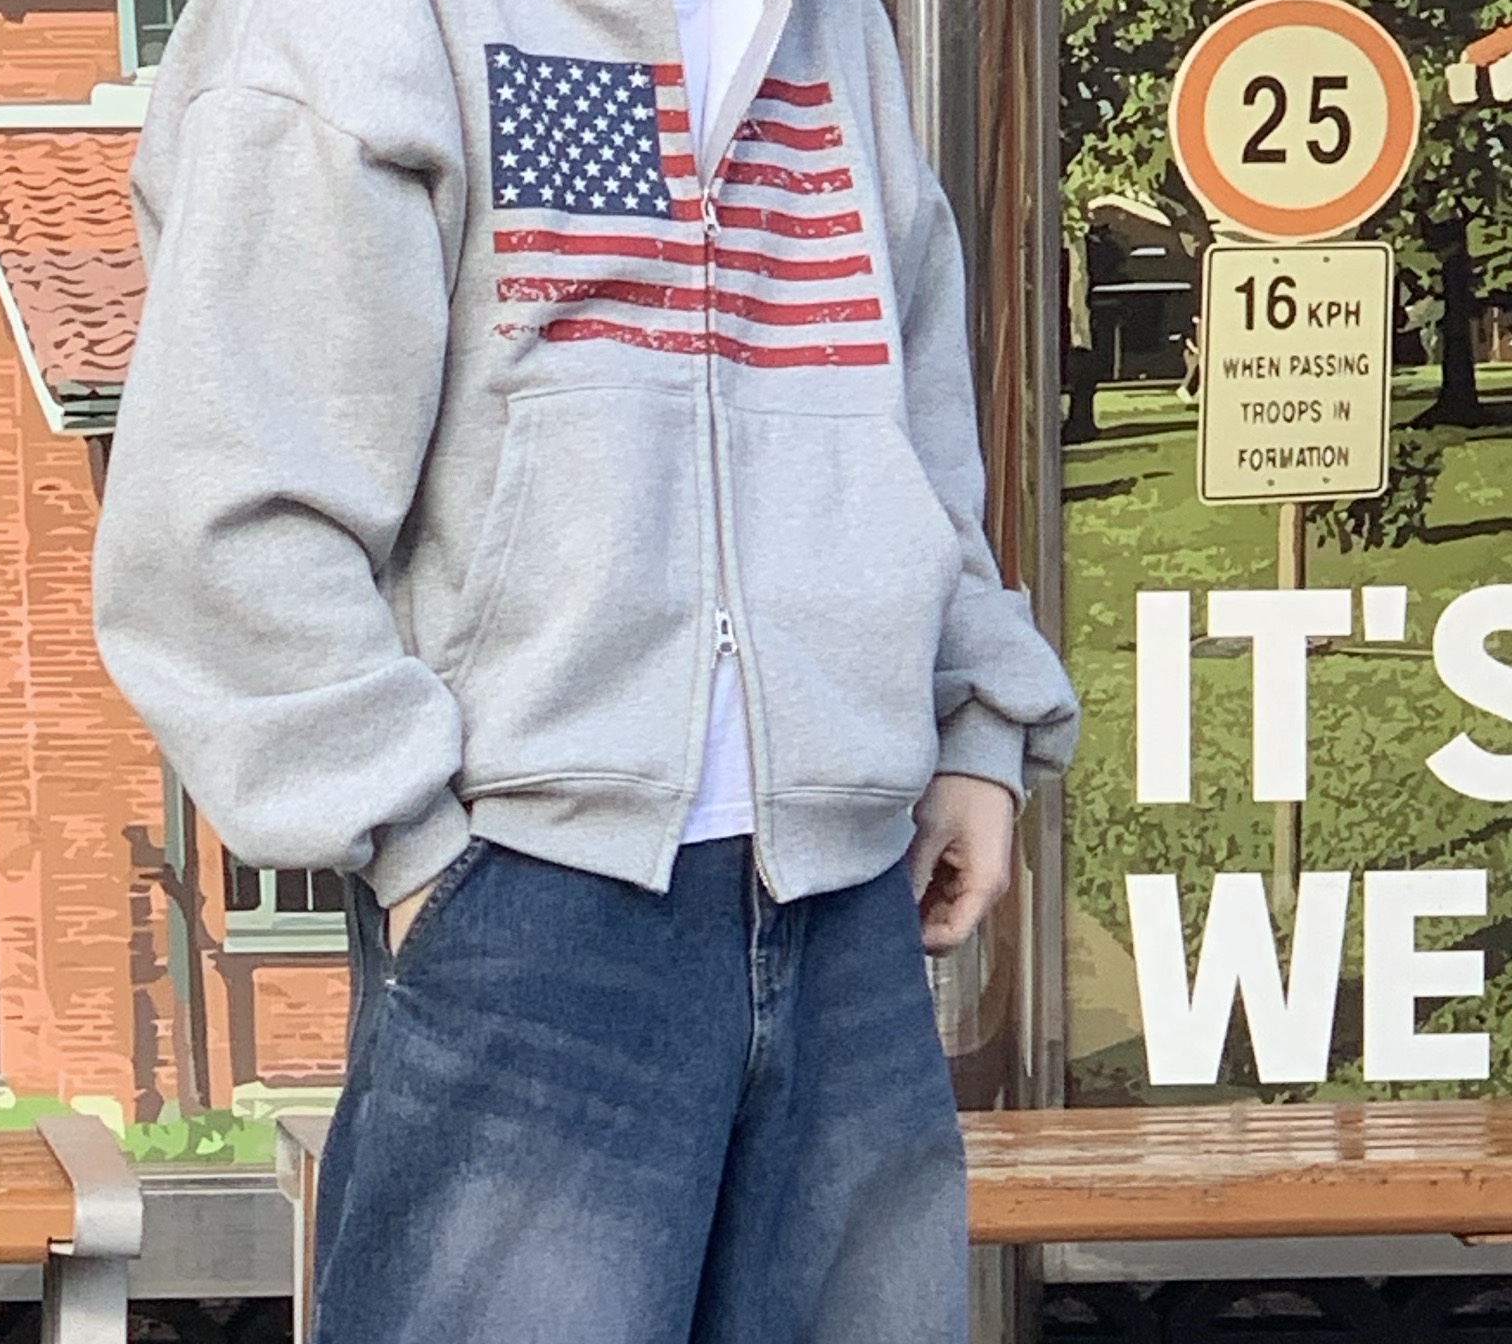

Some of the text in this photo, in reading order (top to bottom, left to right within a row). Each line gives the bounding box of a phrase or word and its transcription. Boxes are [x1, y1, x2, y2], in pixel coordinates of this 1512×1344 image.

[1241, 75, 1352, 165] 25
[1234, 275, 1361, 331] 16 KPH
[1222, 353, 1370, 379] WHEN PASSING
[1240, 401, 1351, 424] TROOPS IN
[1238, 446, 1350, 471] FORMATION
[1136, 583, 1512, 803] IT'S
[1125, 869, 1490, 1086] WE
